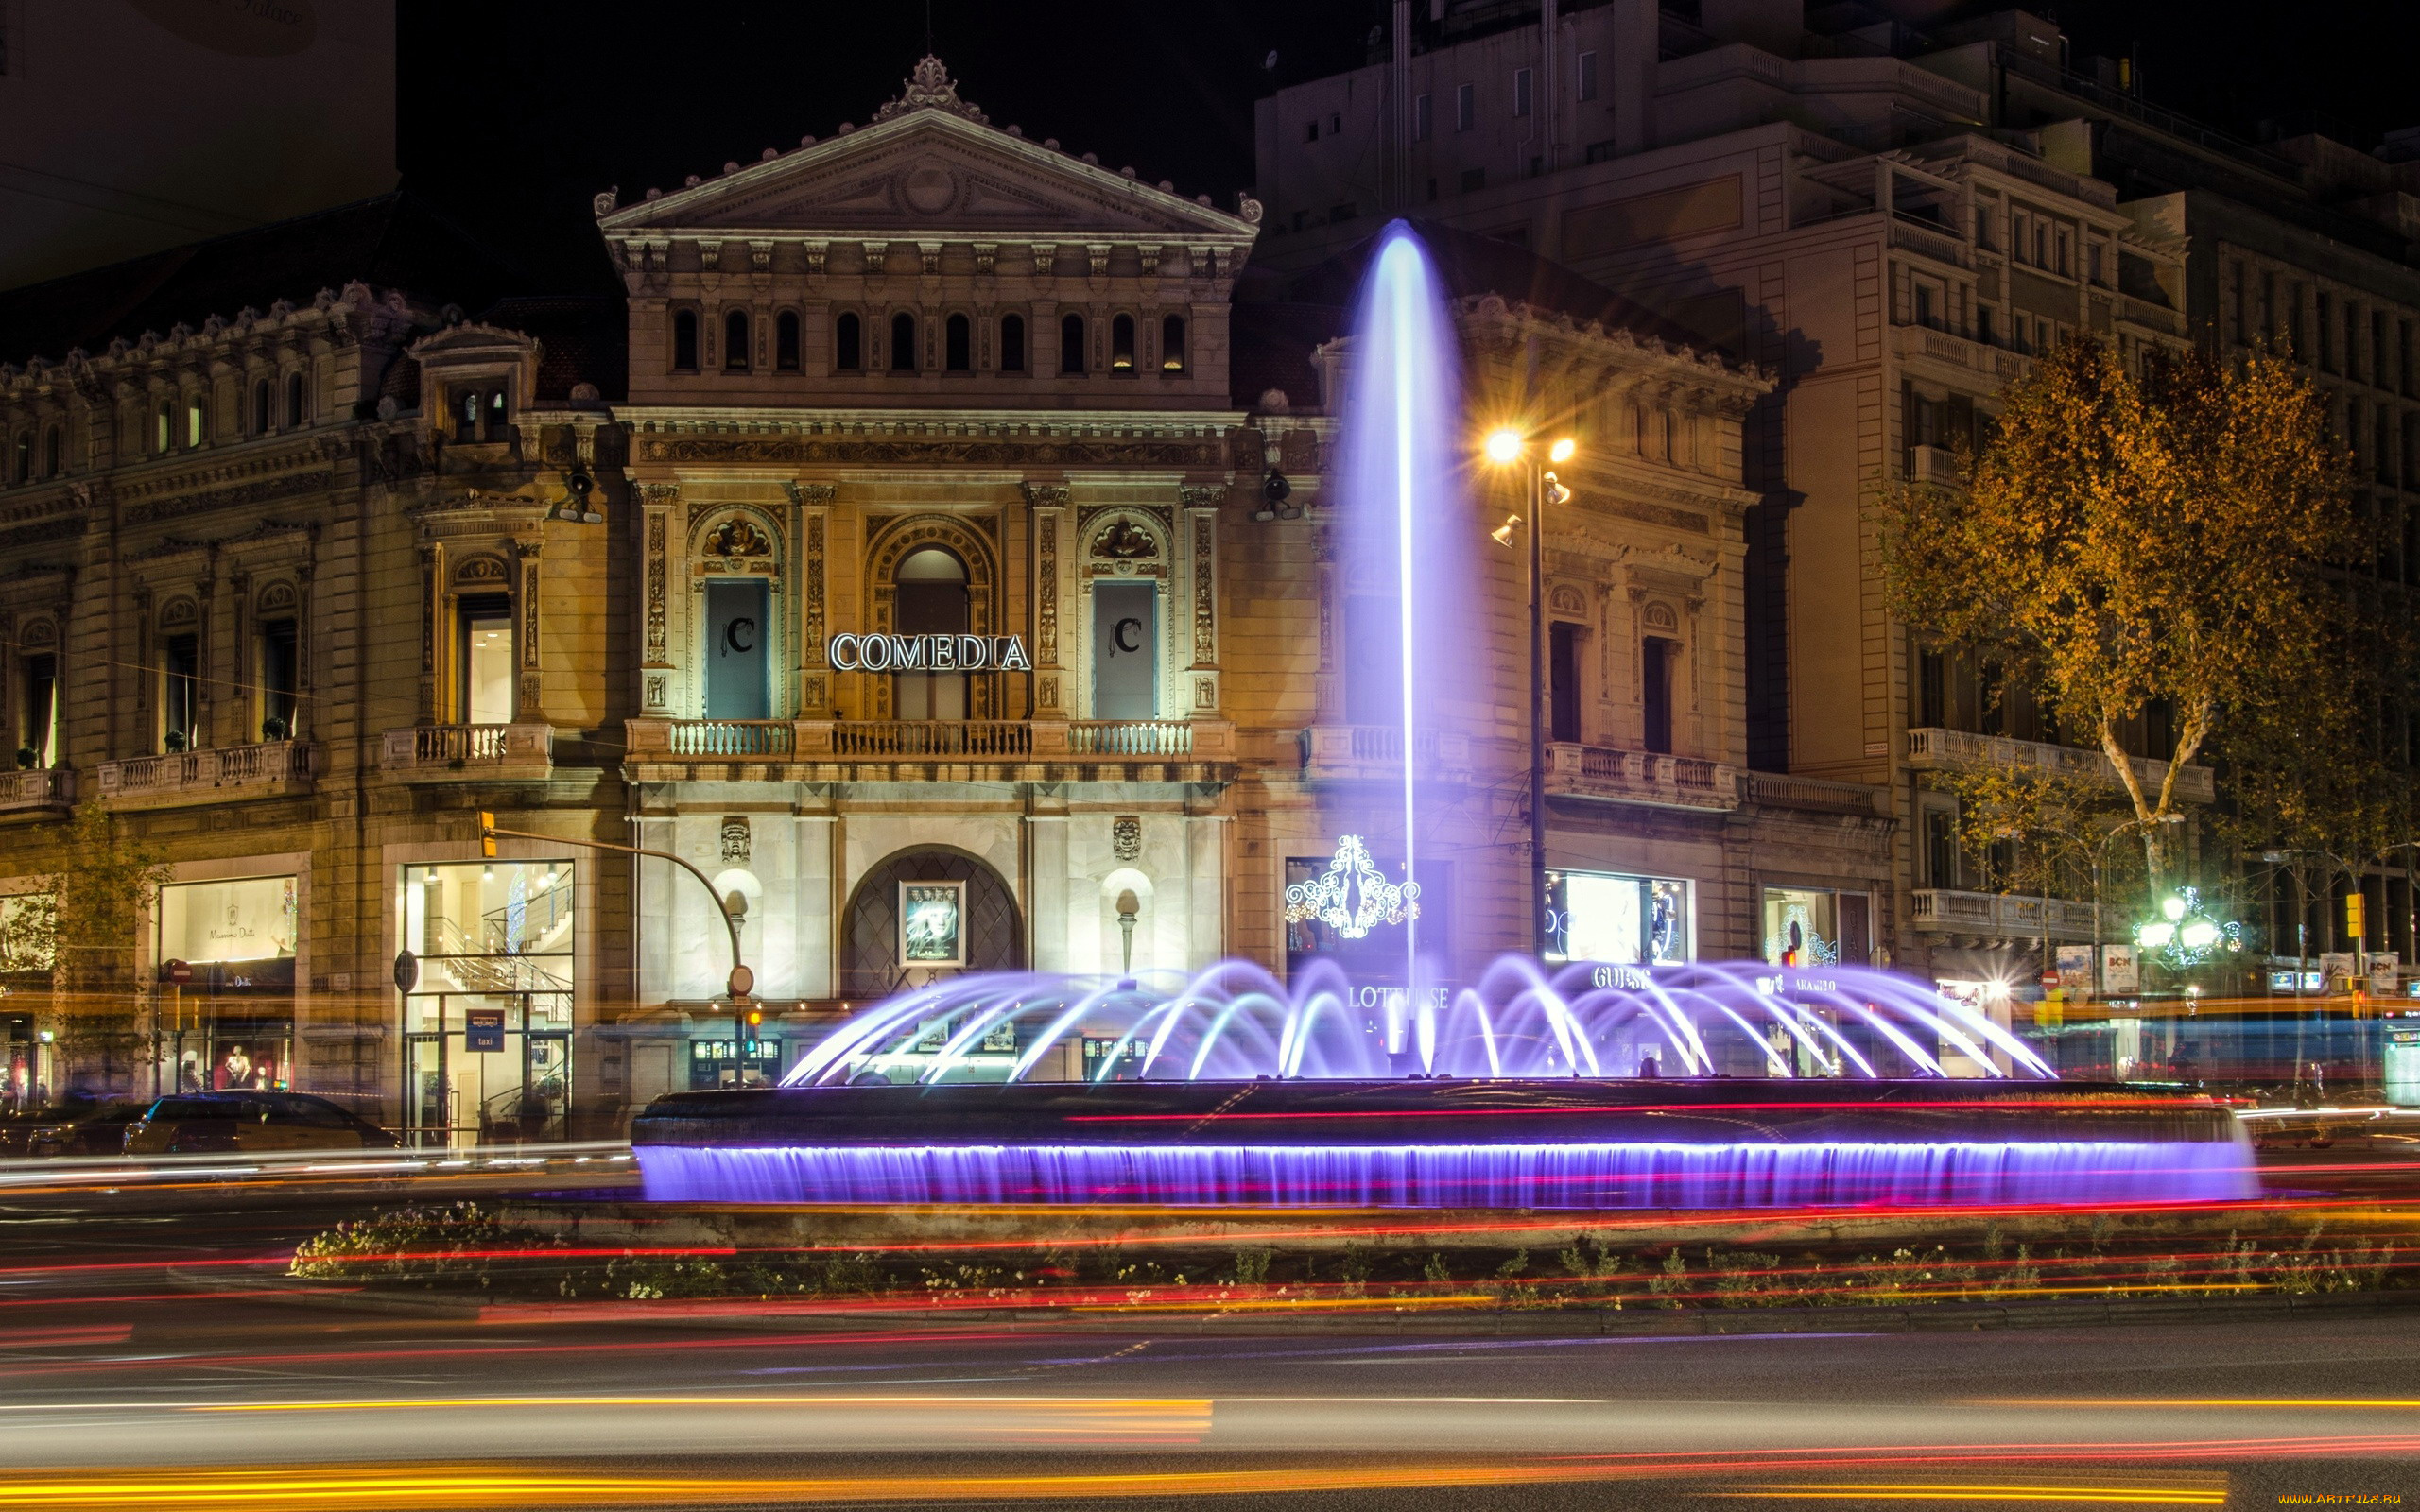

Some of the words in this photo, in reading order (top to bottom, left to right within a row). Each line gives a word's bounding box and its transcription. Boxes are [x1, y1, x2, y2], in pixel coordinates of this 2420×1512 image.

[831, 632, 1032, 671] COMEDIA
[2109, 957, 2131, 967] BCN
[477, 1037, 493, 1046] taxi
